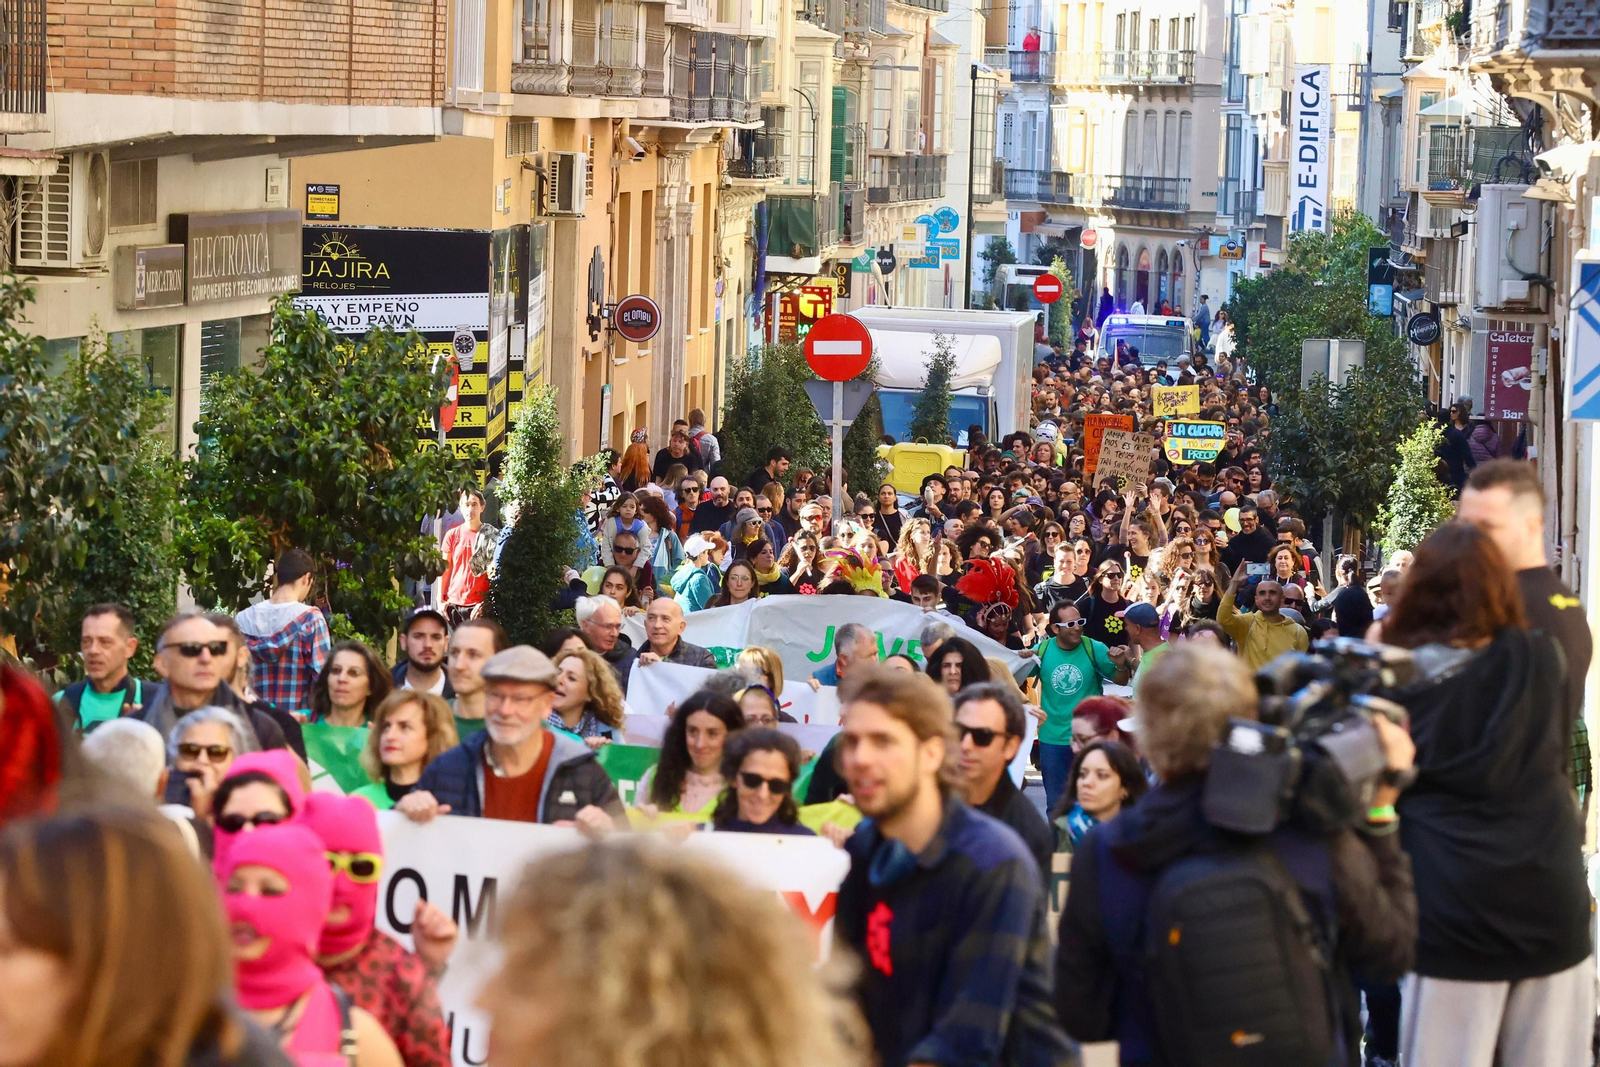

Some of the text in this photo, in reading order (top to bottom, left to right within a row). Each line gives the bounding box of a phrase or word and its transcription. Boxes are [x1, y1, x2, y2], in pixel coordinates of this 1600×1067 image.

[1319, 70, 1328, 164] CONSTRUCCIÓN
[1298, 70, 1321, 188] E-DIFICA
[193, 232, 270, 279] ELECTRONICA
[941, 246, 958, 256] RO
[146, 269, 182, 293] MERCATRON
[313, 281, 356, 290] RELOJES
[192, 275, 298, 301] COMPONENTES Y TELECOMUNICACIONES
[331, 303, 340, 313] Y
[347, 299, 420, 313] EMPEÑO
[327, 314, 415, 326] AND PAWN
[1502, 410, 1524, 420] Bar
[1173, 424, 1186, 436] LA
[1187, 424, 1224, 437] CULTURA
[1121, 442, 1131, 450] ES
